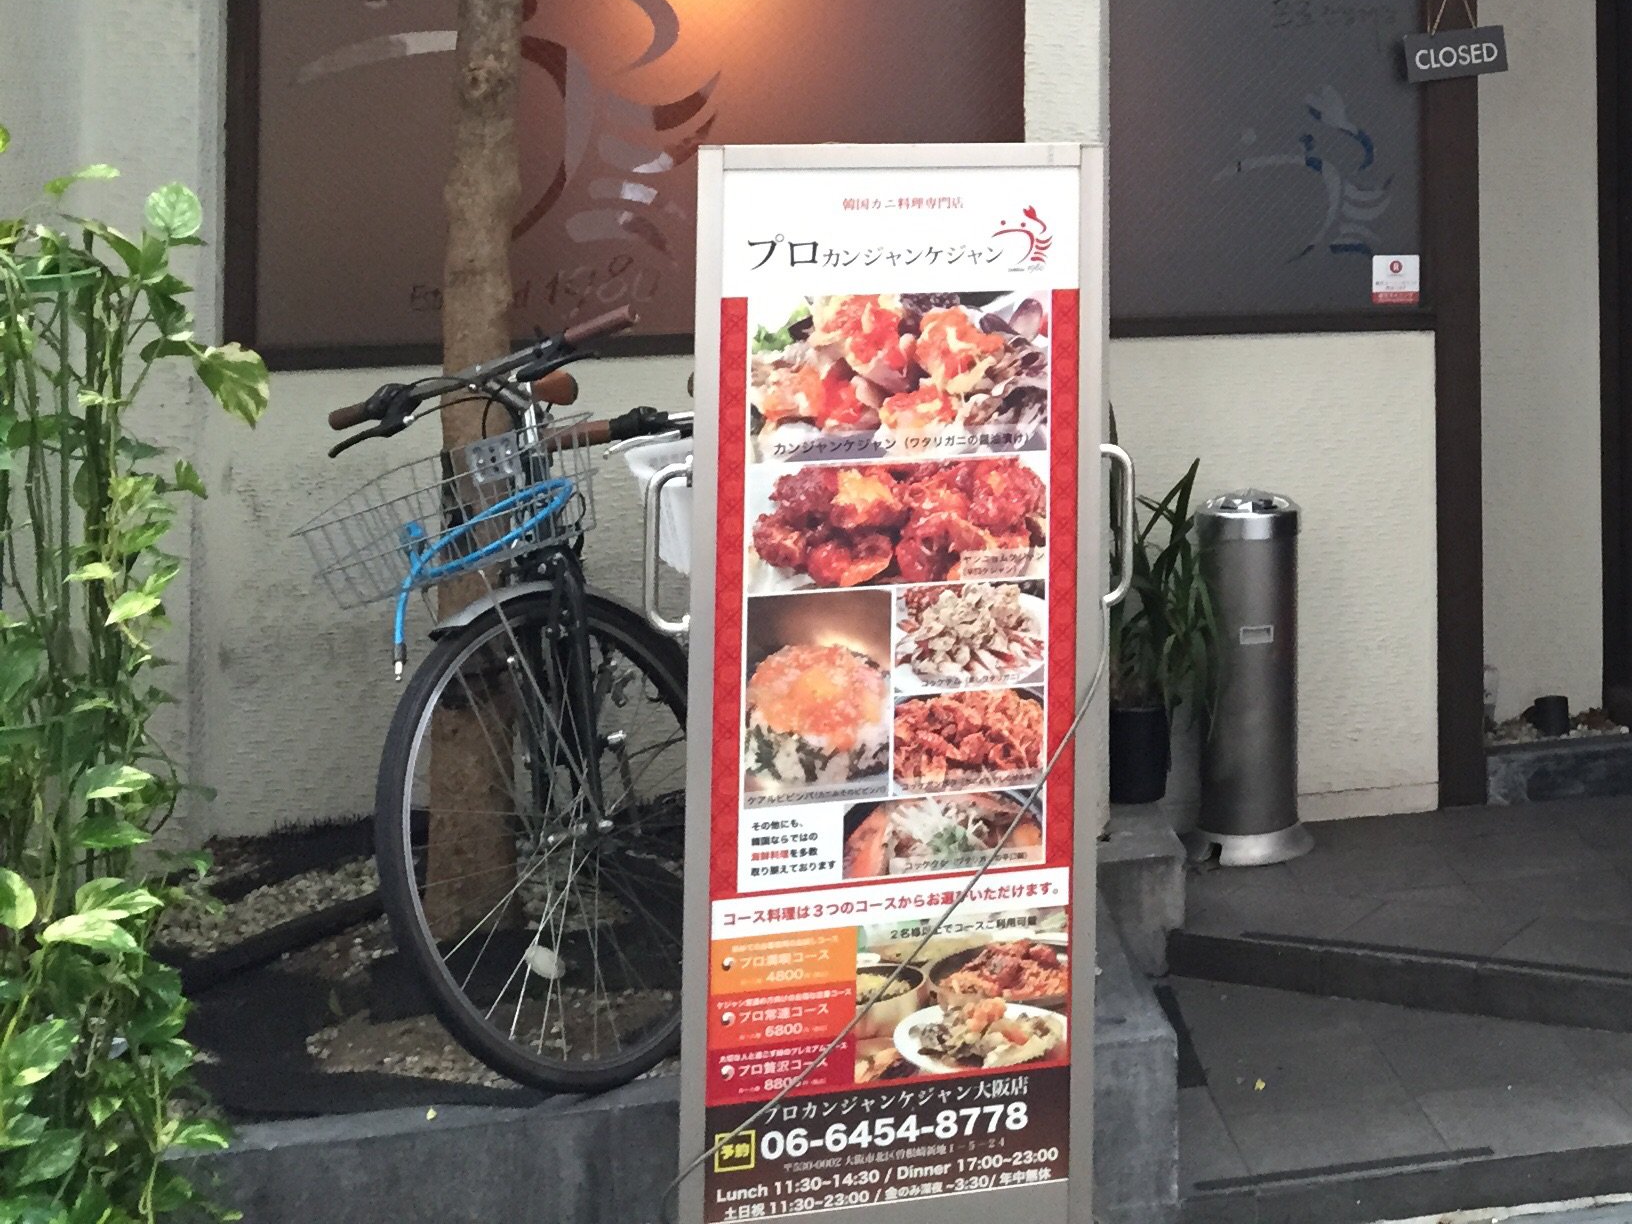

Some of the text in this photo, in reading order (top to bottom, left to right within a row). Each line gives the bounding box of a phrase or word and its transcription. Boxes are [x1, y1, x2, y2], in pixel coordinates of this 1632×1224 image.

[1415, 42, 1498, 70] CLOSED
[842, 197, 964, 211] 韓国カニ料理専門店
[748, 233, 1004, 271] プロカンジャンケジャン
[766, 968, 804, 982] 4800
[764, 1022, 803, 1037] 6800
[760, 1101, 1029, 1160] 06-6454-8778
[716, 1184, 768, 1203] Lunch
[896, 1163, 952, 1180] Dinner
